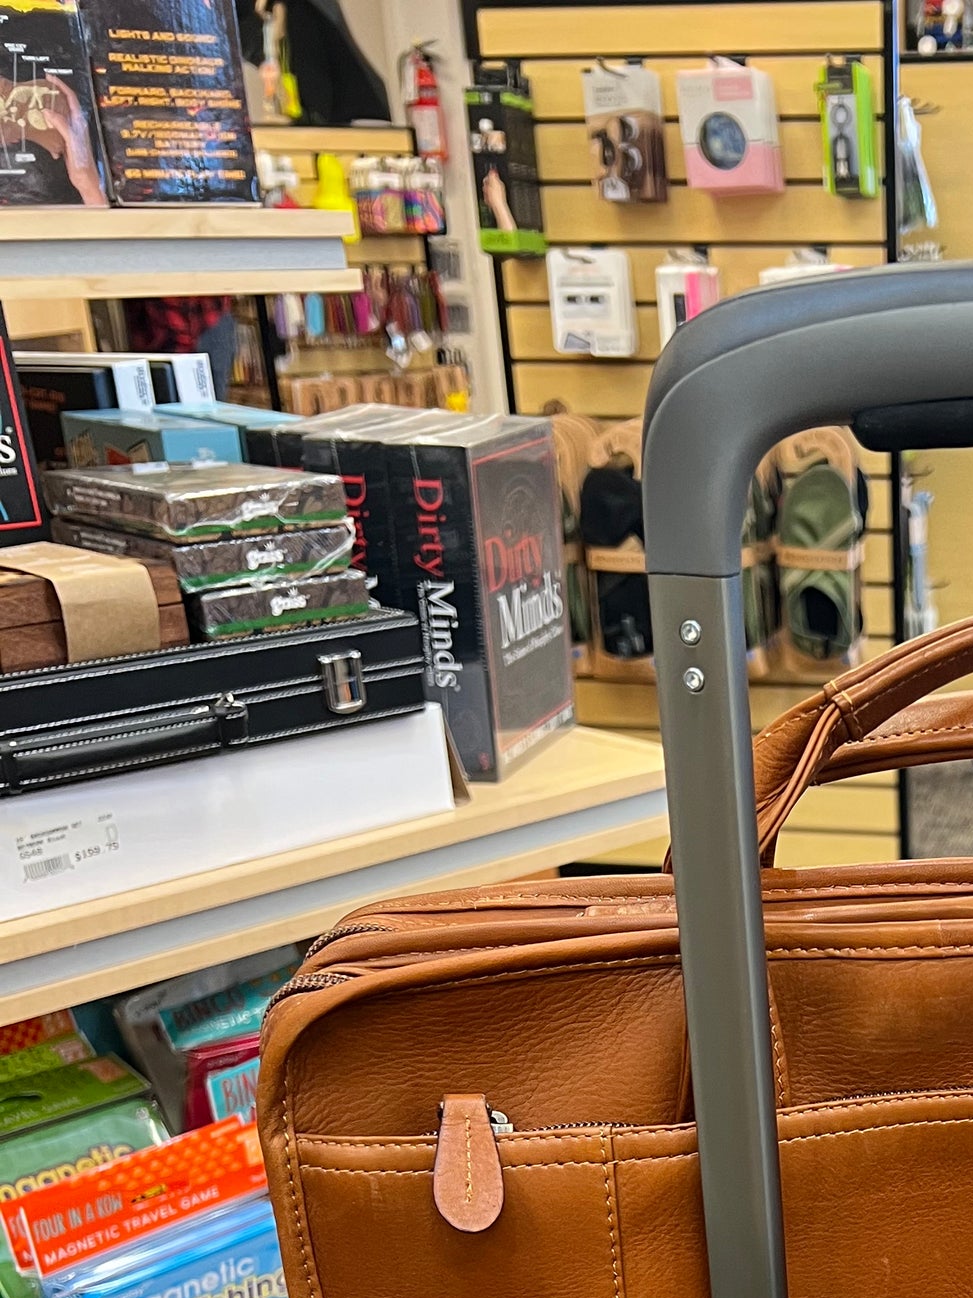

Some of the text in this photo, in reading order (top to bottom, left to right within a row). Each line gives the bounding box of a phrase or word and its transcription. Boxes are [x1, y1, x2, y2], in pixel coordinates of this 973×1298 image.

[413, 476, 464, 689] Dirty Minds
[484, 529, 543, 594] Dirty
[497, 571, 563, 649] Minds
[222, 1068, 259, 1114] BIN
[34, 1193, 123, 1244] FOUR IN A ROW
[43, 1187, 220, 1267] MAGNETIC TRAVEL GAME
